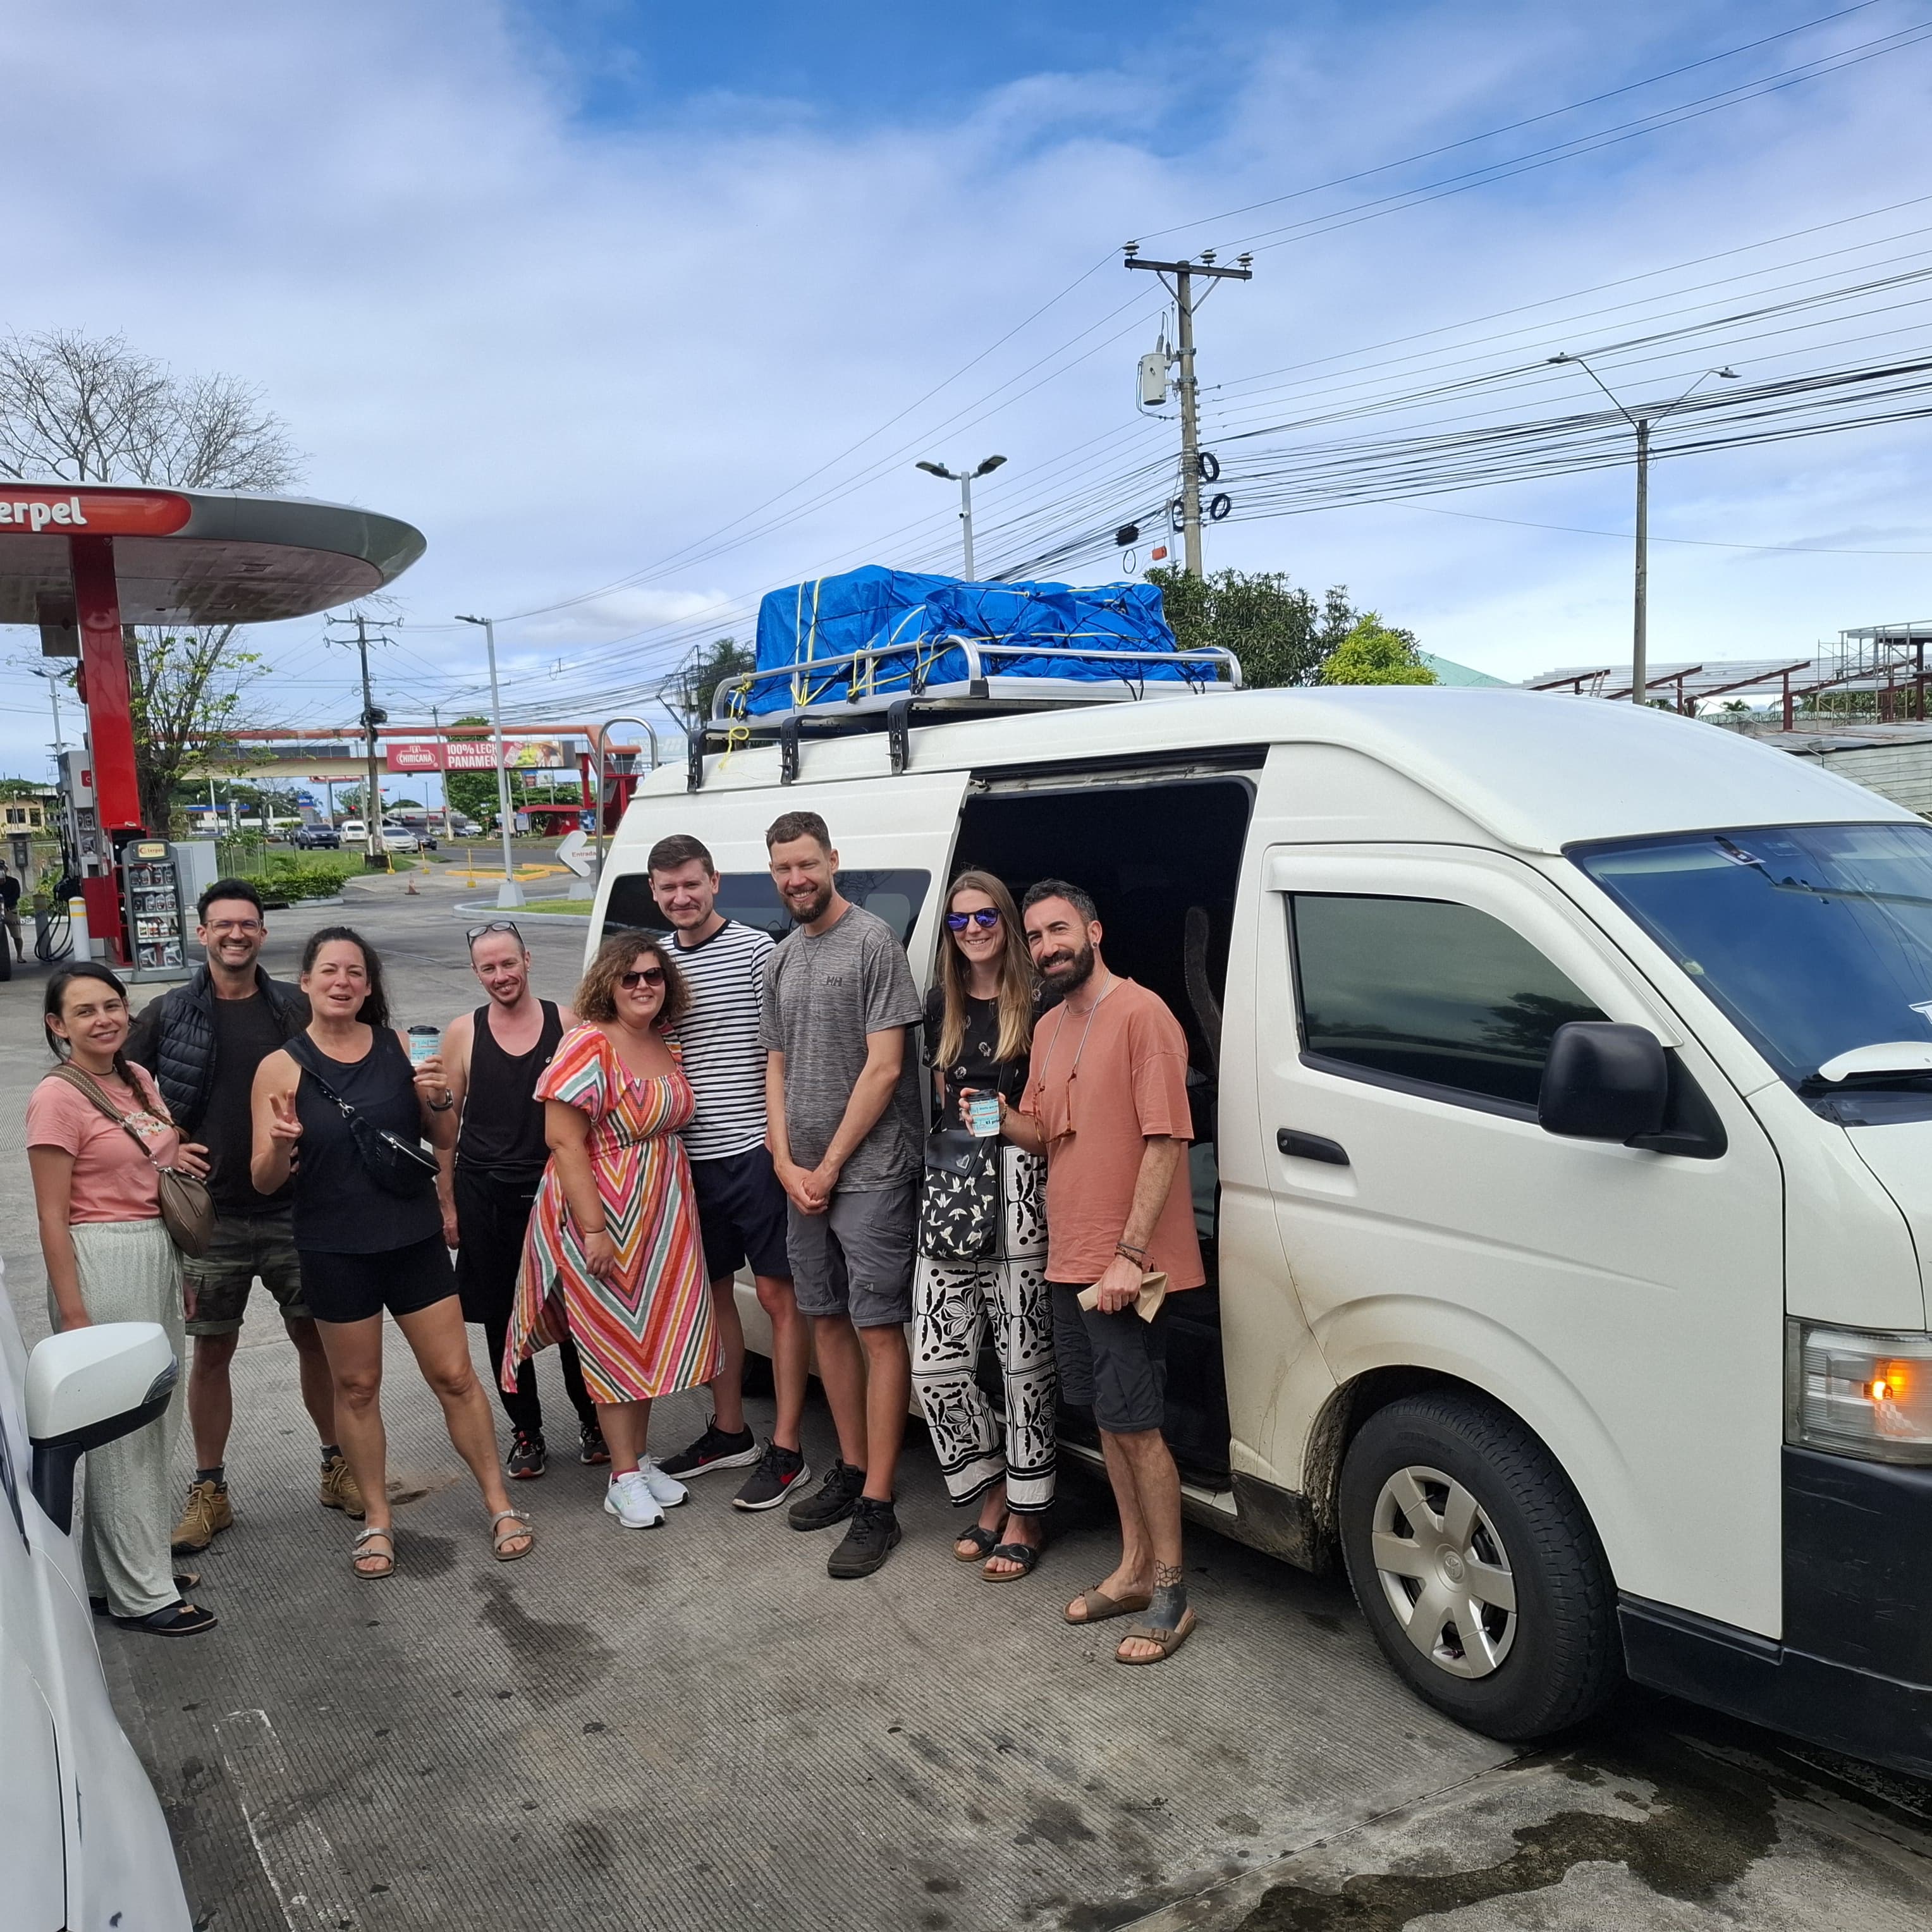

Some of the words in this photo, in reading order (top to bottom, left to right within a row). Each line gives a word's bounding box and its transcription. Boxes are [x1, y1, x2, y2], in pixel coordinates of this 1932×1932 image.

[0, 496, 87, 531] erpel
[447, 743, 474, 755] 100%
[476, 743, 498, 754] LECH
[399, 754, 432, 763] CHIRICANA
[448, 753, 498, 767] PANAMEÑ
